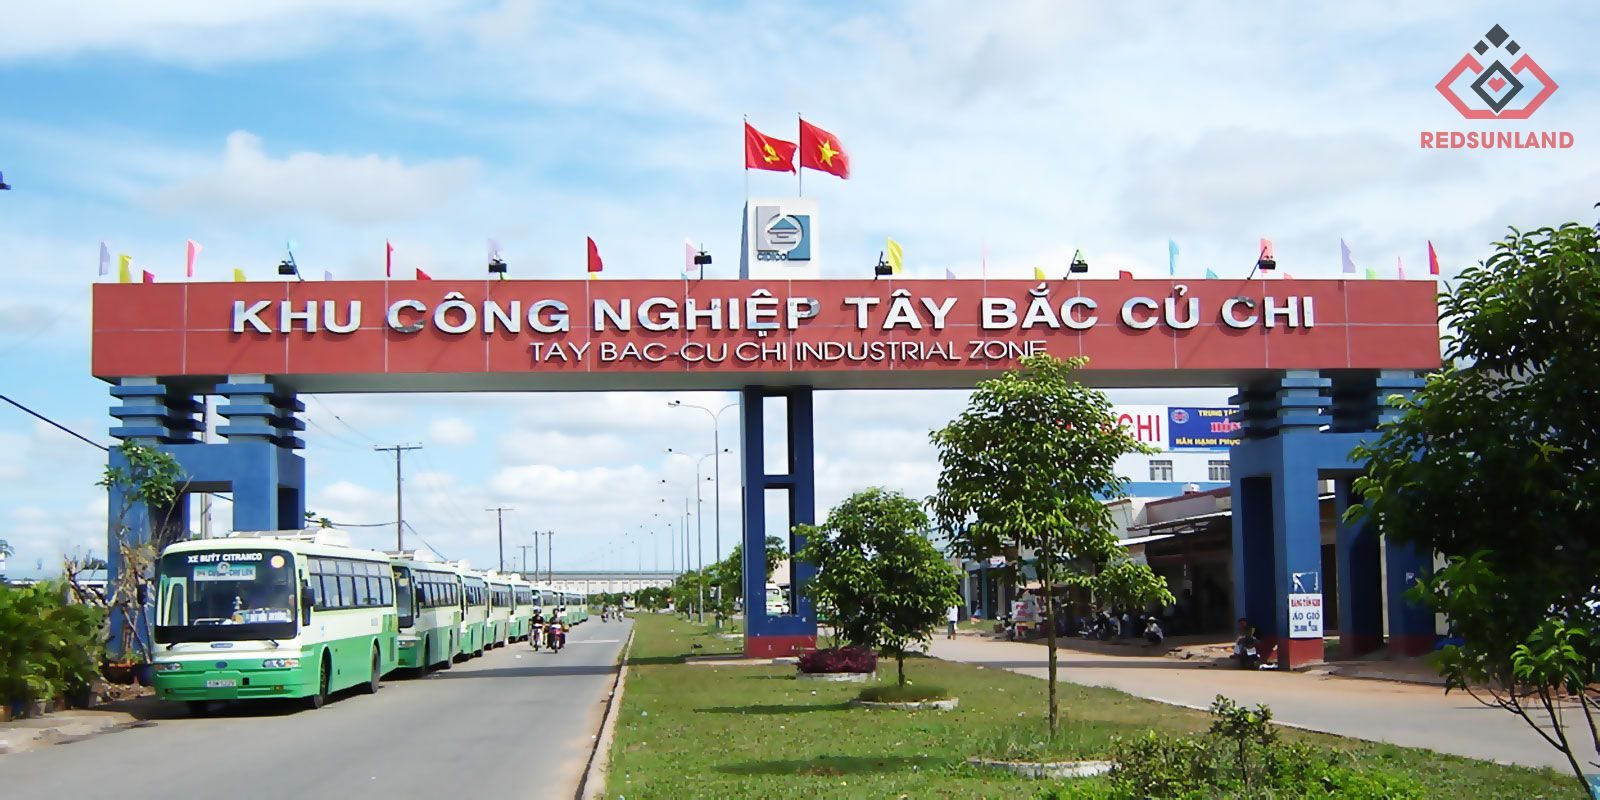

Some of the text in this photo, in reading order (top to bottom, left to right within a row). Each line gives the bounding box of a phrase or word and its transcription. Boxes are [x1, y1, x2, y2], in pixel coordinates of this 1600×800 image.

[232, 282, 1315, 337] KHU CÔNG NGHIỆP TÂY BẮC CỦ CHI
[529, 341, 592, 362] TAY
[735, 341, 787, 362] CHI
[796, 340, 962, 362] INDUSTRIAL
[968, 339, 1048, 360] ZONE
[1198, 409, 1223, 417] TRUNG
[222, 552, 263, 561] CITRANCO
